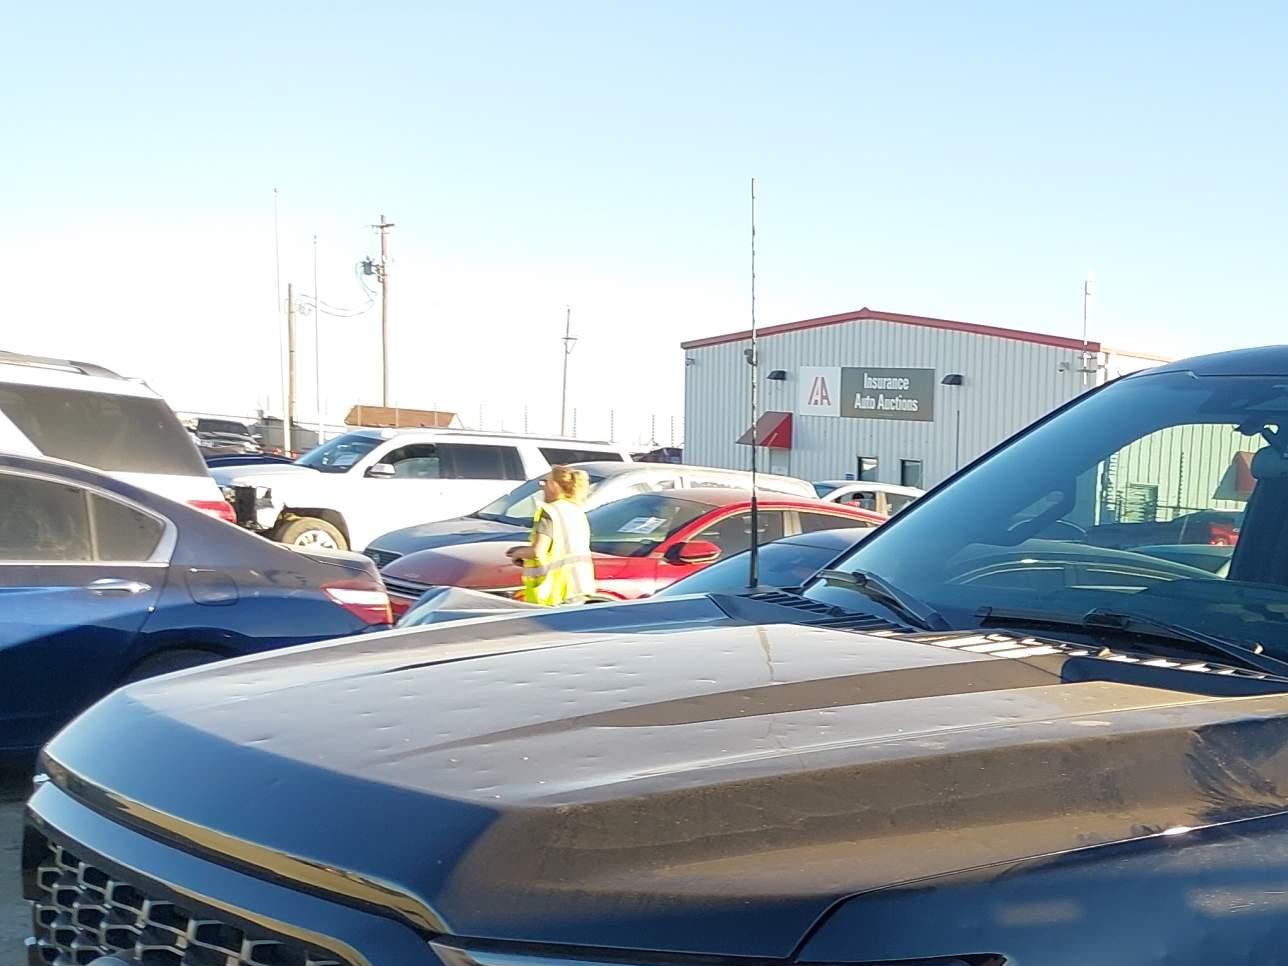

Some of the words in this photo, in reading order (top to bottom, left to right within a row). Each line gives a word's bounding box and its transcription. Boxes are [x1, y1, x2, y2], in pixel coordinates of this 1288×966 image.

[863, 372, 911, 390] Insurance
[854, 392, 876, 410] Auto
[877, 393, 919, 412] Auctions
